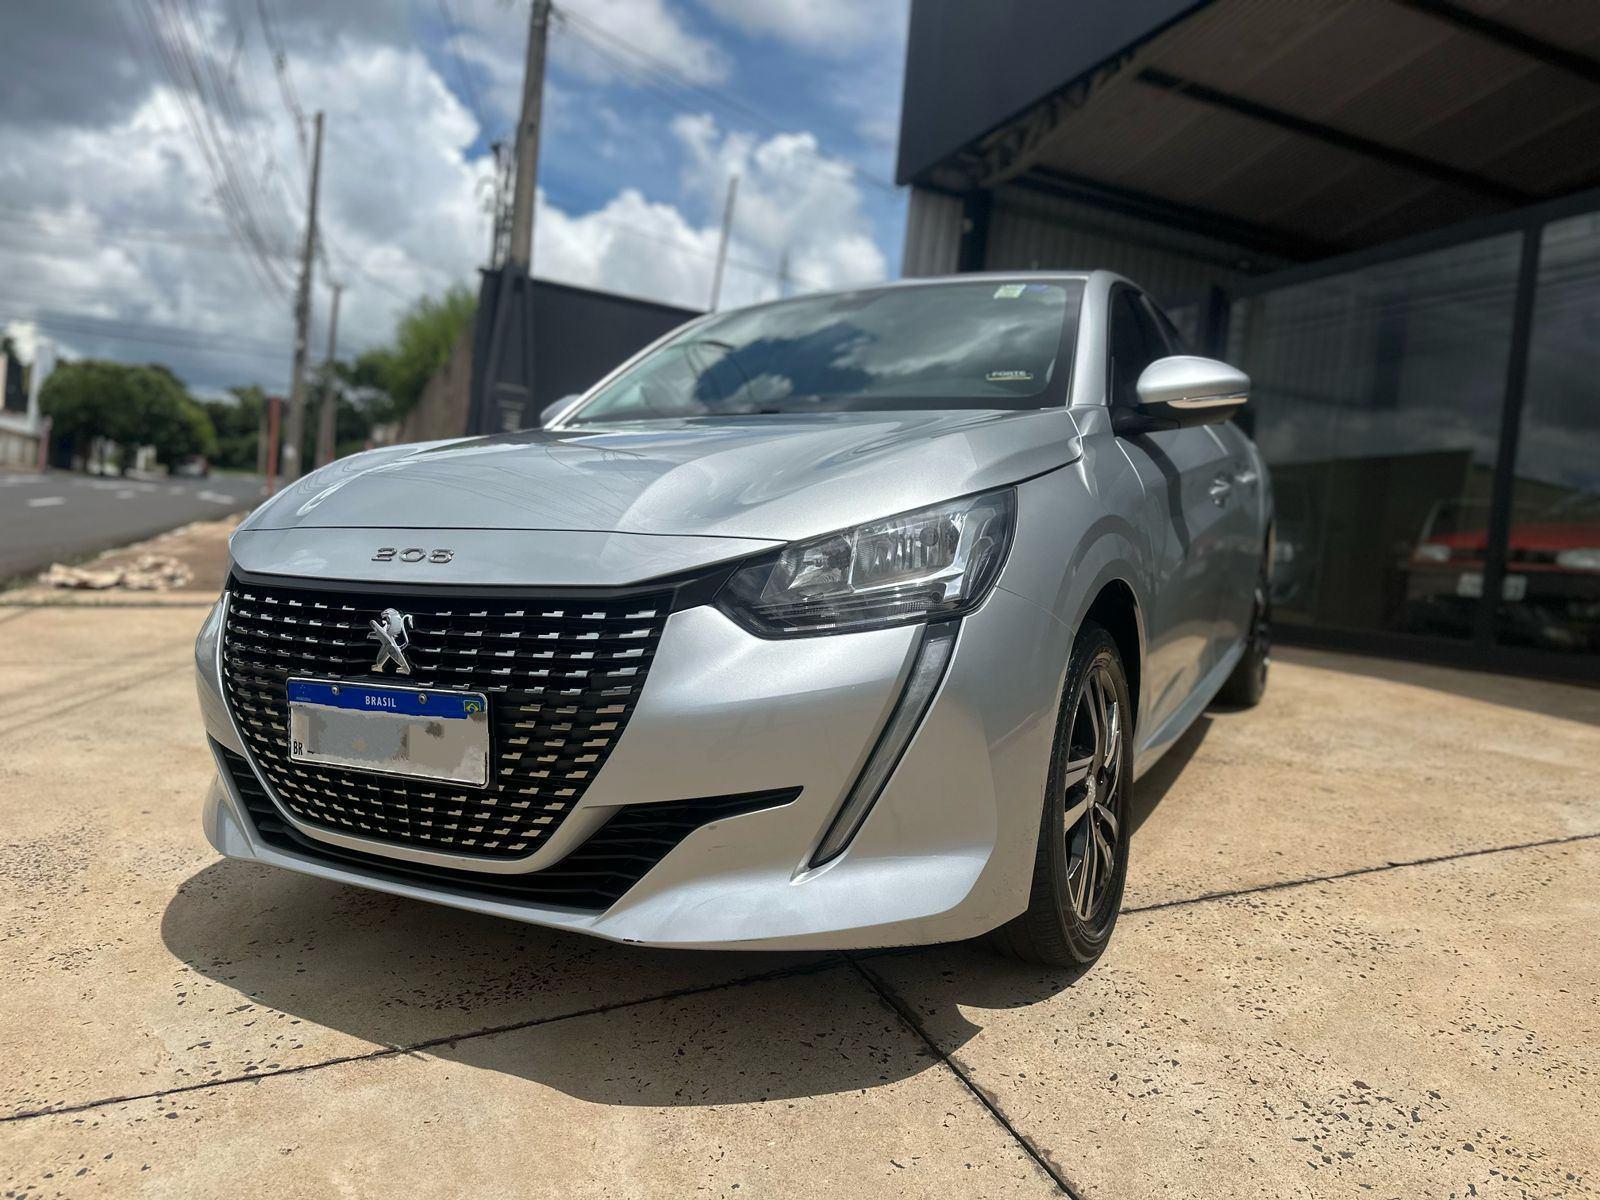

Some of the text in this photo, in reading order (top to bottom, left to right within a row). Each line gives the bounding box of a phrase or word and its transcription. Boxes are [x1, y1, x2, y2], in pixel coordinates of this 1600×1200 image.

[371, 547, 454, 564] 208
[365, 696, 397, 707] BRASIL
[293, 741, 303, 756] BR
